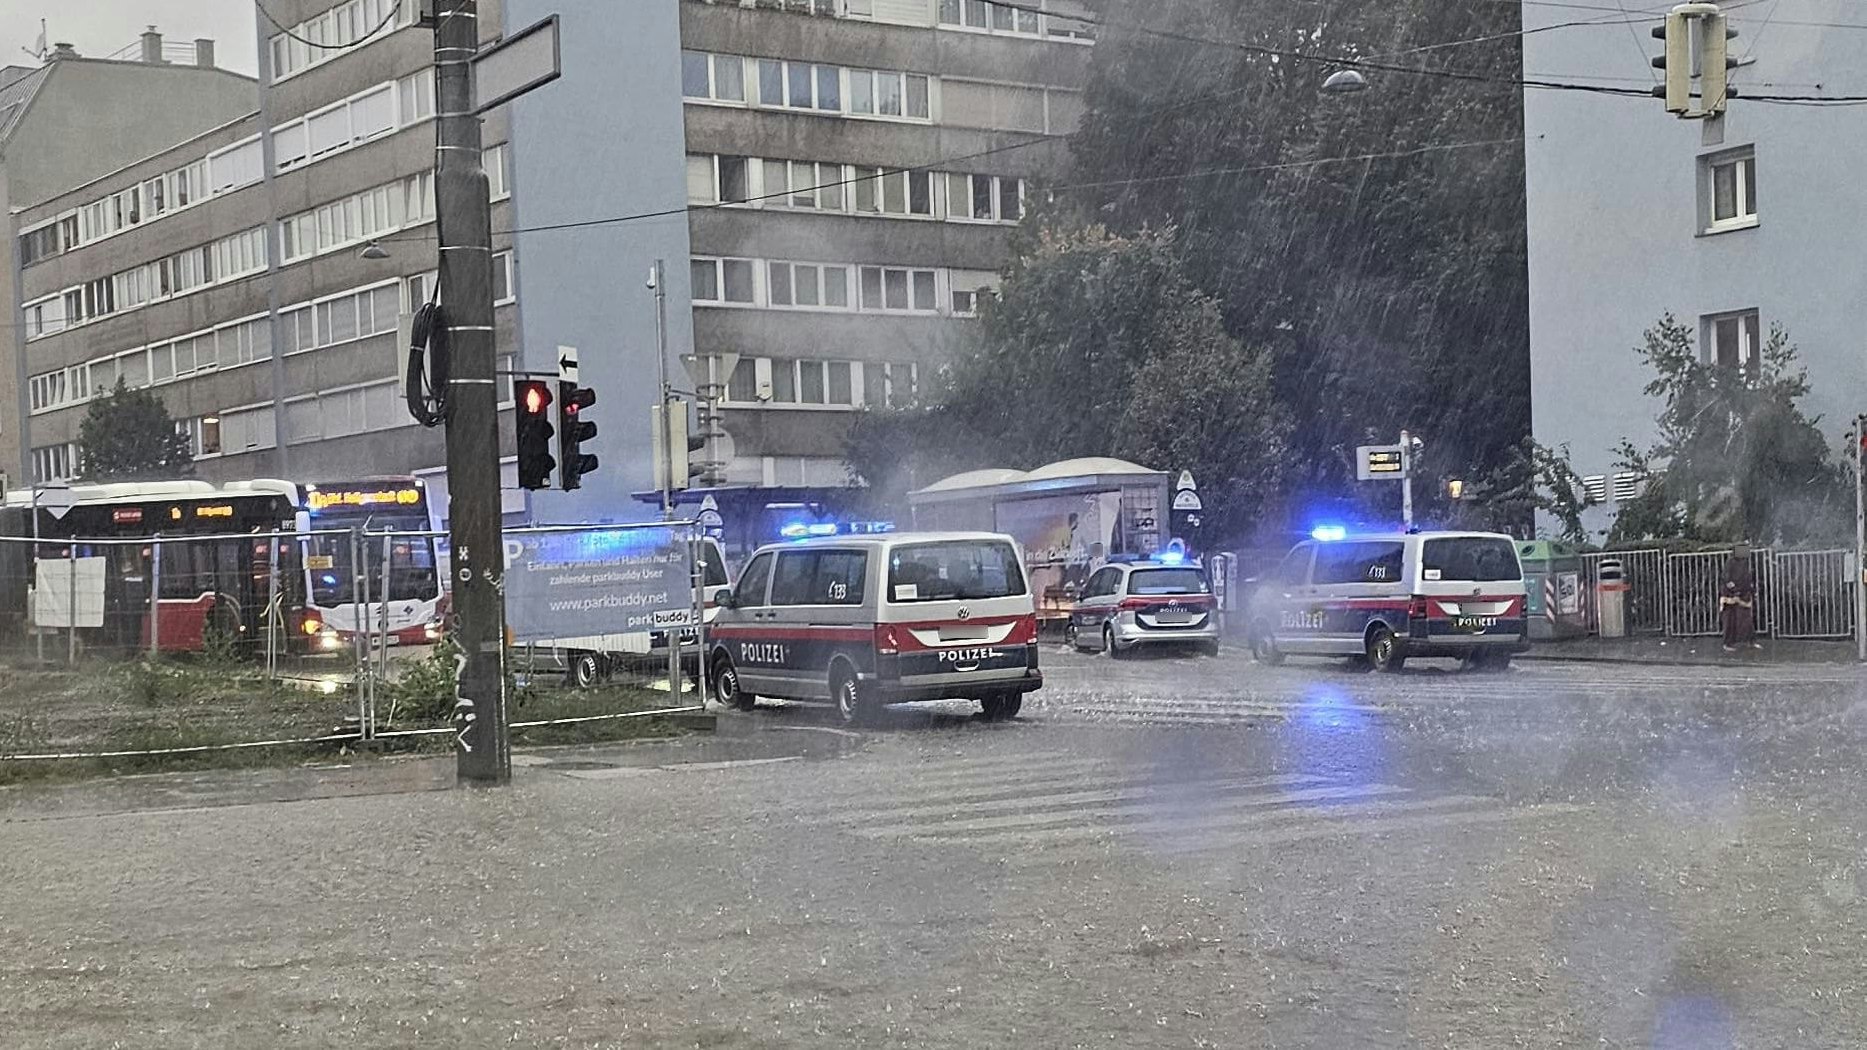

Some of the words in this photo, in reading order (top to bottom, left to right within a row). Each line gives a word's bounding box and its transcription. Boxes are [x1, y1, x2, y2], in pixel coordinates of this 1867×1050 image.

[592, 569, 640, 584] parkbuddy
[642, 568, 663, 579] User
[834, 583, 847, 600] 133
[550, 592, 667, 611] www.parkbuddy.net
[741, 643, 785, 663] POLIZEI
[939, 648, 993, 662] POLIZEI
